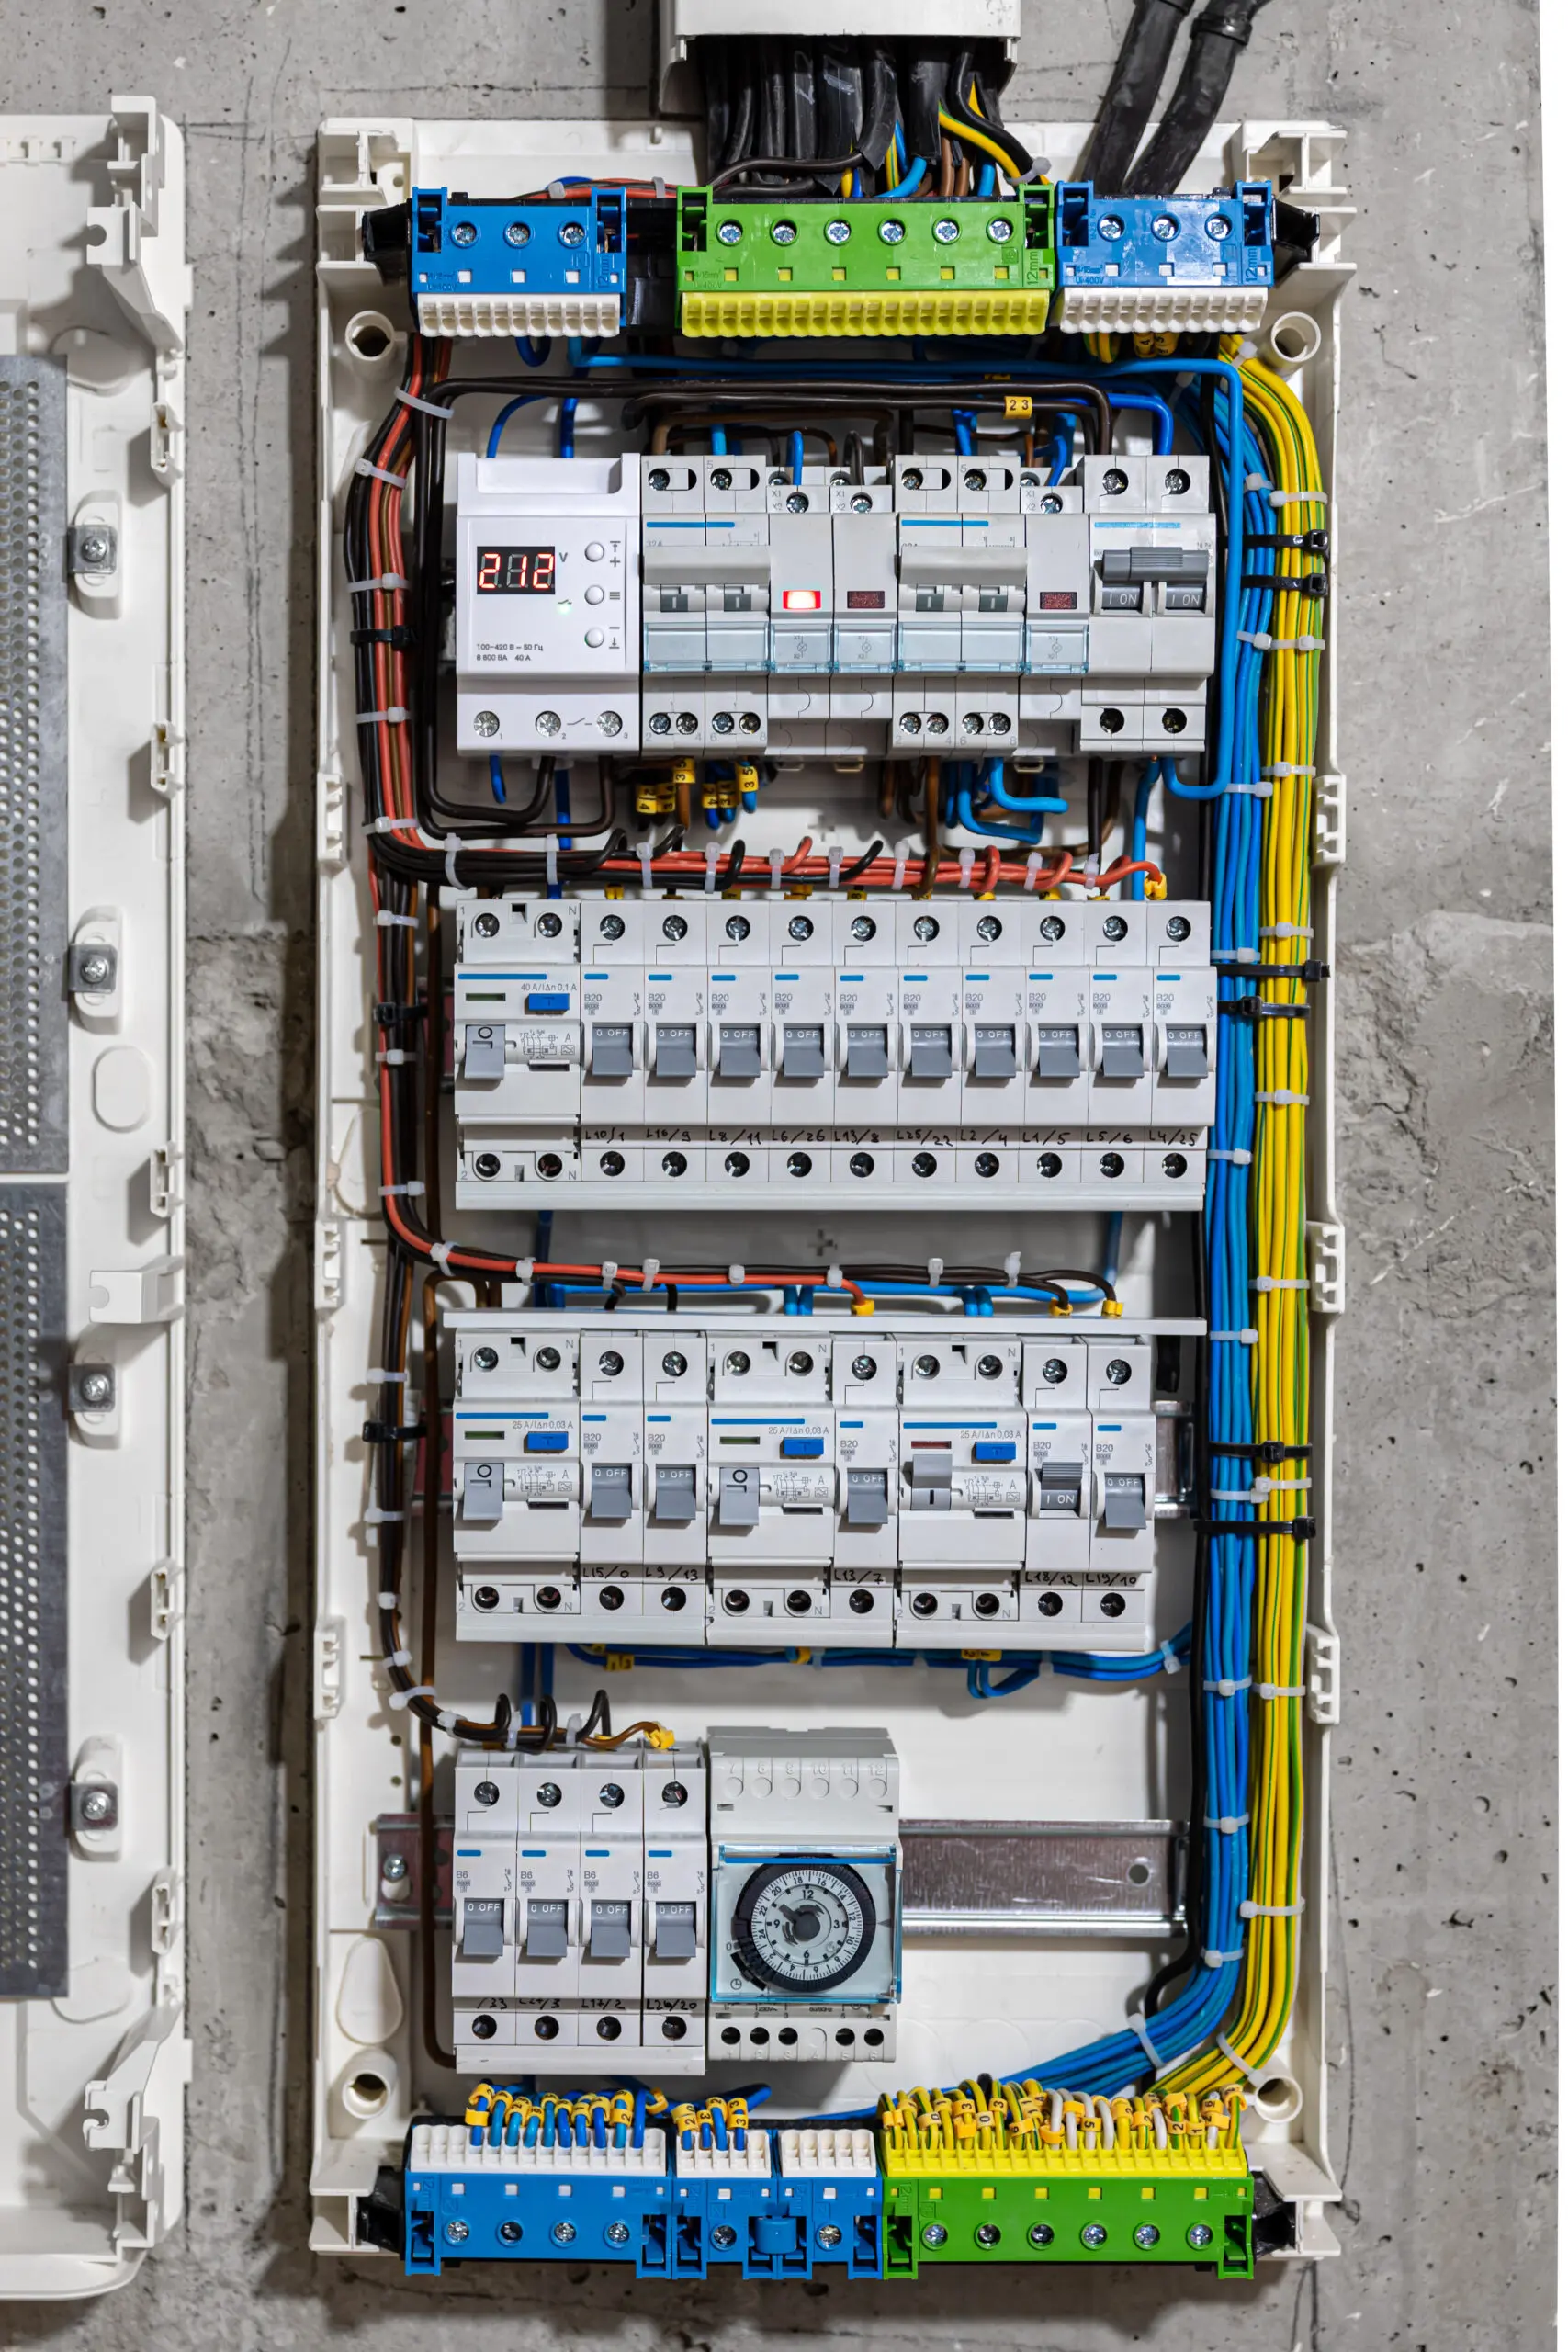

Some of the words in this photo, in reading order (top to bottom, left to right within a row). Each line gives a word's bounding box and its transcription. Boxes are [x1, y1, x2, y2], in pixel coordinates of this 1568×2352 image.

[706, 460, 714, 469] 5
[558, 552, 568, 562] V
[479, 553, 555, 589] 212
[1120, 593, 1138, 605] ON
[1182, 594, 1200, 605] ON
[645, 733, 653, 741] 2
[694, 733, 702, 741] 4
[710, 733, 717, 741] 6
[759, 733, 767, 741] 8
[895, 736, 903, 744] 2
[944, 736, 952, 744] 4
[960, 736, 967, 745] 6
[1009, 736, 1017, 745] 8
[568, 906, 577, 915] N
[521, 983, 530, 991] 40
[557, 983, 569, 992] 0,1
[570, 983, 577, 991] A
[648, 993, 666, 1001] B20
[711, 993, 729, 1001] B20
[774, 993, 793, 1001] B20
[965, 993, 984, 1001] B20
[1156, 993, 1174, 1001] B20
[607, 1028, 629, 1036] OFF
[734, 1030, 755, 1038] OFF
[797, 1030, 819, 1038] OFF
[861, 1030, 881, 1038] OFF
[924, 1030, 945, 1038] OFF
[1115, 1030, 1137, 1038] OFF
[564, 1034, 571, 1043] A
[460, 1170, 468, 1181] 2
[568, 1170, 577, 1181] N
[565, 1340, 574, 1349] N
[818, 1344, 827, 1353] N
[1008, 1348, 1017, 1357] N
[513, 1420, 523, 1430] 25
[548, 1420, 566, 1430] 0,03
[567, 1420, 574, 1430] A
[805, 1427, 822, 1435] 0,03
[960, 1430, 970, 1439] 25
[997, 1430, 1014, 1440] 0,03
[1015, 1430, 1021, 1439] A
[583, 1433, 602, 1442] B20
[648, 1434, 665, 1442] B20
[840, 1440, 858, 1448] B20
[1032, 1442, 1051, 1450] B20
[1096, 1444, 1113, 1453] B20
[561, 1469, 570, 1479] A
[606, 1469, 627, 1477] OFF
[671, 1470, 692, 1478] OFF
[818, 1475, 825, 1485] A
[863, 1475, 885, 1483] OFF
[1118, 1478, 1139, 1487] OFF
[1010, 1480, 1017, 1489] A
[1057, 1495, 1075, 1504] ON
[564, 1602, 572, 1611] N
[708, 1606, 716, 1615] 2
[814, 1606, 823, 1615] N
[897, 1609, 904, 1618] 2
[1001, 1609, 1010, 1619] N
[456, 1871, 468, 1879] B6
[583, 1871, 596, 1879] B6
[793, 1876, 804, 1884] 18
[817, 1877, 827, 1886] 16
[772, 1885, 782, 1896] 20
[802, 1889, 814, 1899] 12
[837, 1890, 847, 1900] 14
[479, 1903, 501, 1911] OFF
[542, 1904, 563, 1913] OFF
[607, 1905, 628, 1914] OFF
[671, 1905, 692, 1914] OFF
[759, 1905, 768, 1917] 22
[848, 1912, 856, 1921] 12
[773, 1919, 781, 1928] 9
[833, 1919, 840, 1929] 3
[758, 1928, 766, 1939] 24
[845, 1935, 855, 1945] 10
[803, 1950, 810, 1959] 6
